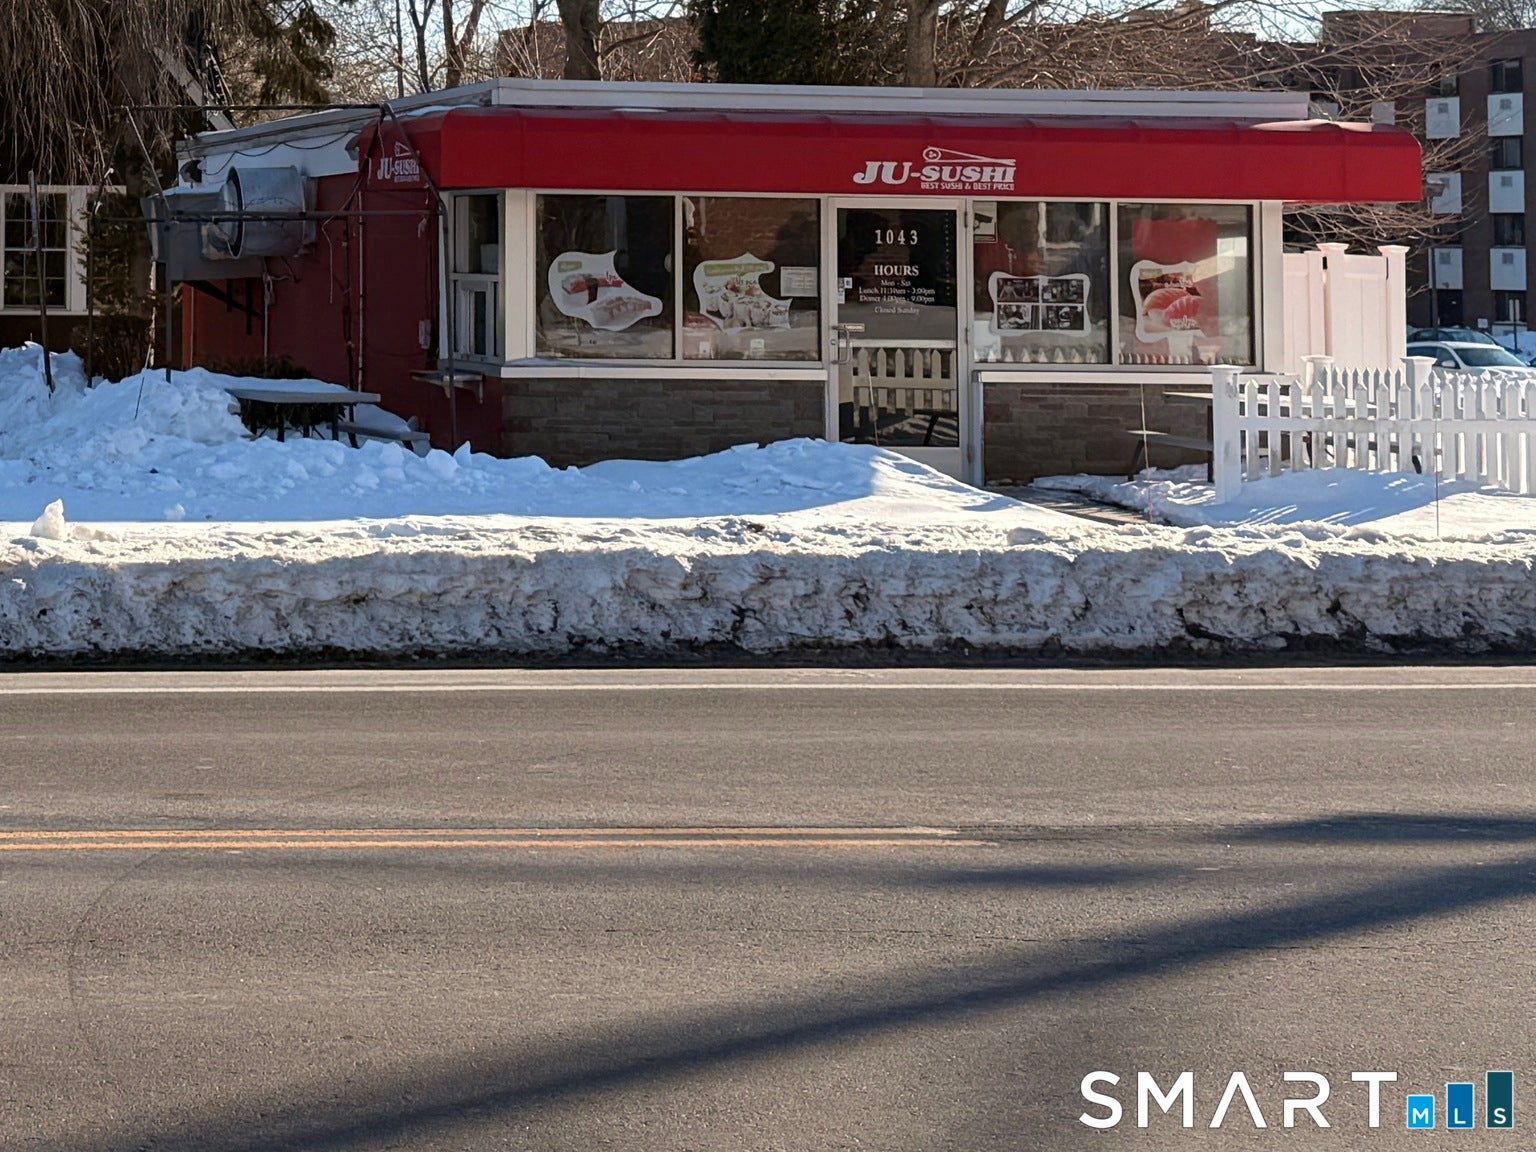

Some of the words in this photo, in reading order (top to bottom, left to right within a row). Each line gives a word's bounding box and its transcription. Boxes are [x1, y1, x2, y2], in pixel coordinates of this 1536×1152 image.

[852, 161, 1016, 185] JU-SUSHI
[920, 182, 939, 190] BEST
[940, 182, 963, 190] SUSHI
[964, 182, 971, 190] &
[874, 229, 919, 245] 1043
[874, 265, 919, 277] HOURS
[900, 279, 912, 287] Sat
[859, 286, 879, 294] Lunch
[874, 306, 897, 314] Closed
[897, 306, 920, 315] Sunday
